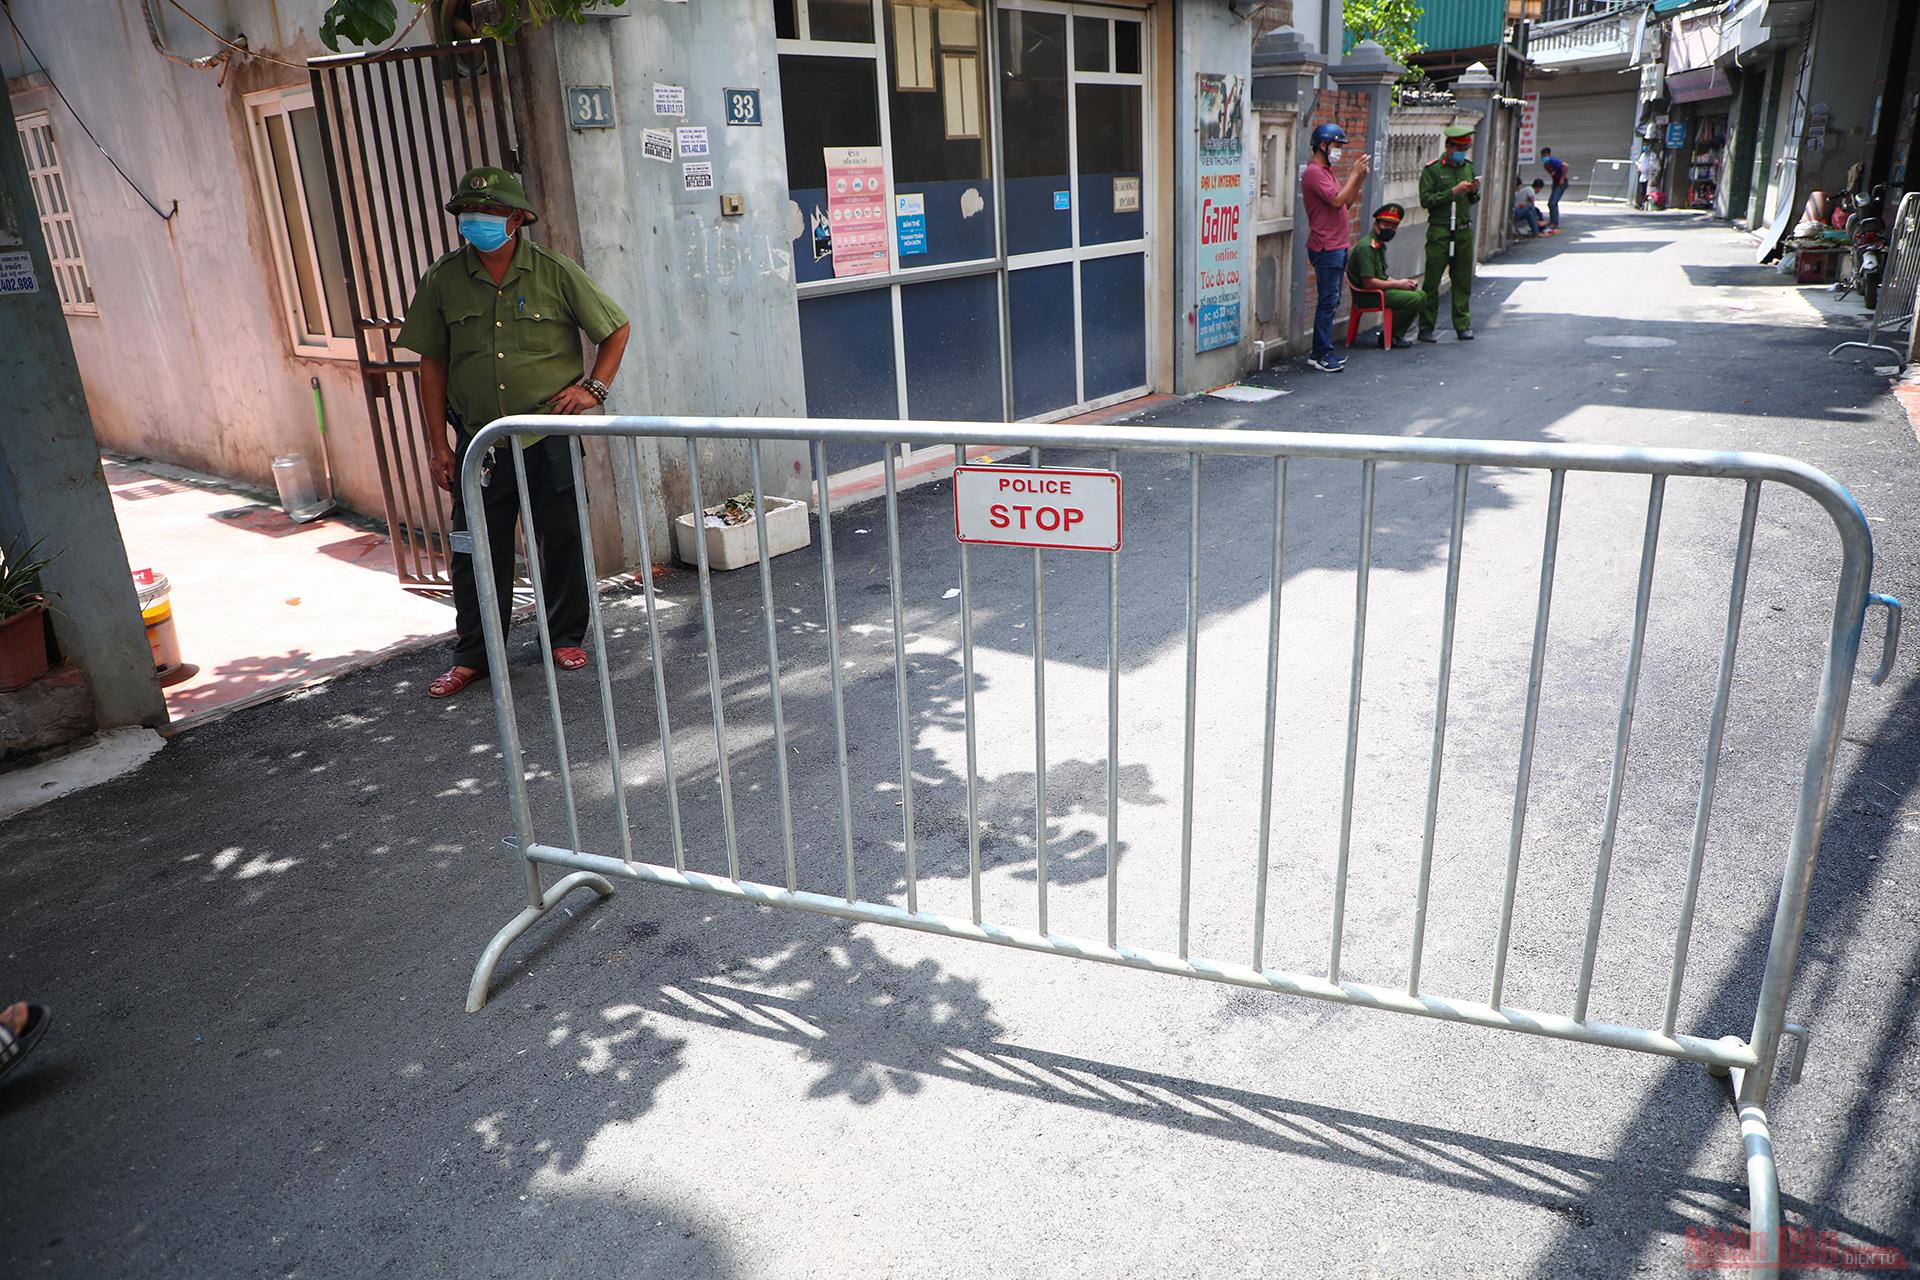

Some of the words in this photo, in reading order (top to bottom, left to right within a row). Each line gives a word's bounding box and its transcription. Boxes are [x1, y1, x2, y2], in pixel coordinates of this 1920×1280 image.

[733, 94, 754, 118] 33
[1218, 174, 1241, 188] INTERNET
[1201, 198, 1240, 245] Game
[1215, 248, 1238, 263] online
[1227, 270, 1240, 285] cao
[999, 478, 1071, 494] POLICE
[989, 504, 1084, 531] STOP
